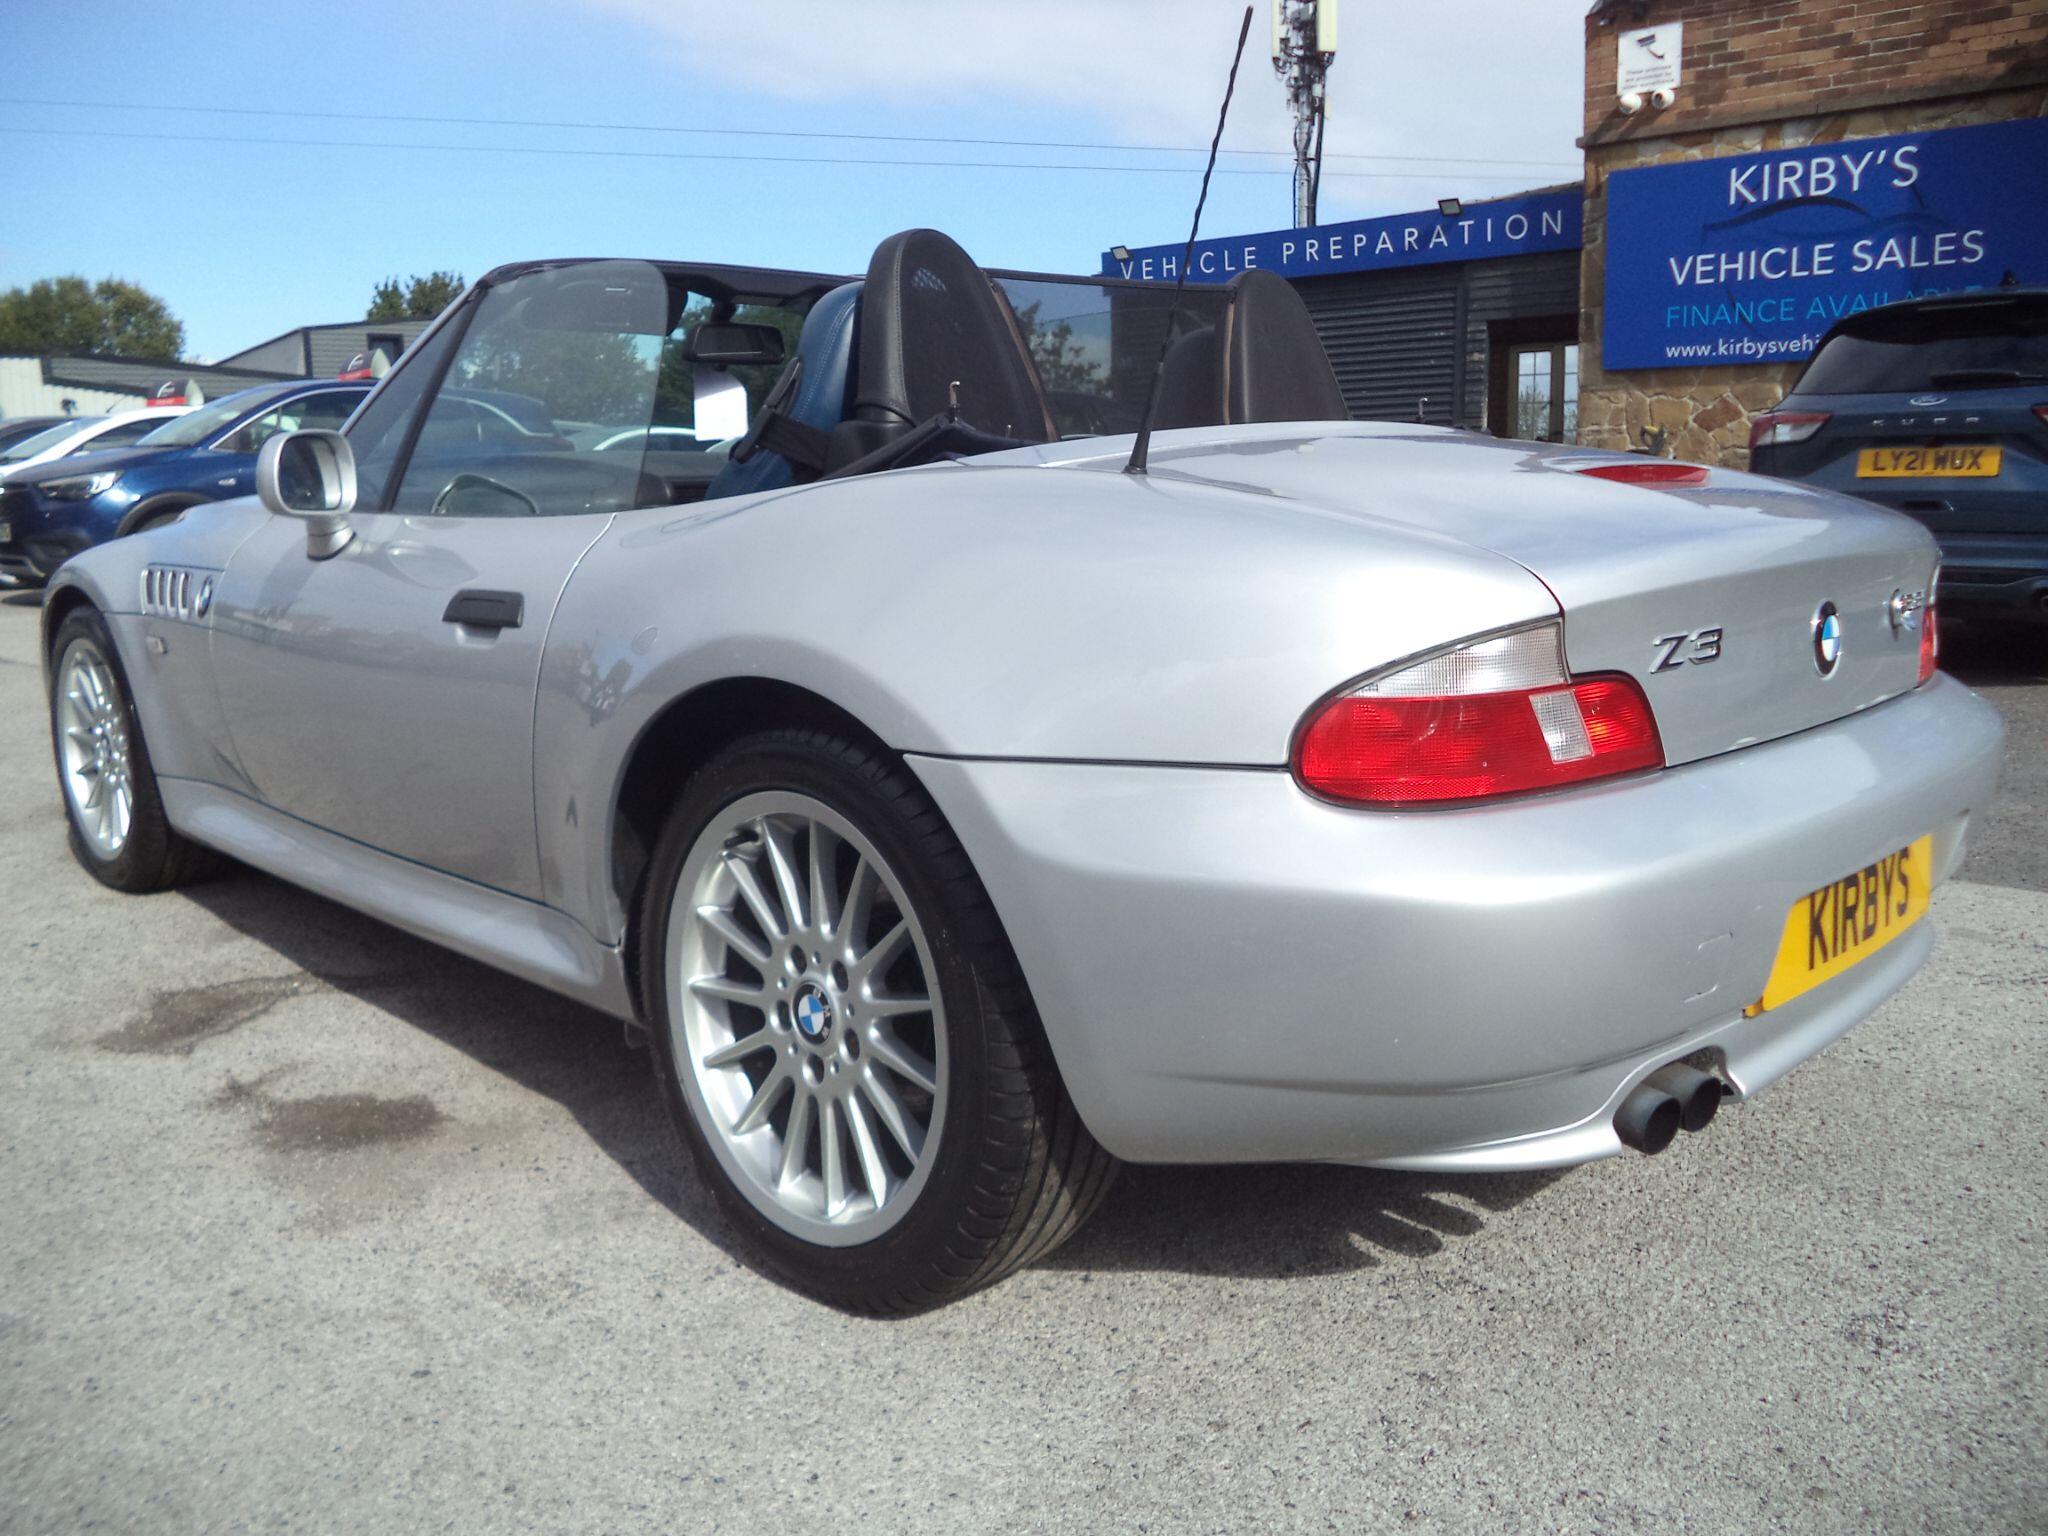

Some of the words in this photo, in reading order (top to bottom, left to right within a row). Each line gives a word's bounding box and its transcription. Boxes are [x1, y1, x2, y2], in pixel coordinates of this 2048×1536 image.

[1728, 145, 1920, 205] KIRBY'S
[1283, 209, 1563, 264] PREPARATION
[1669, 243, 1835, 286] VEHICLE
[1851, 229, 1985, 274] SALES
[1665, 298, 1796, 329] FINANCE
[1649, 625, 1723, 674] Z3
[1809, 846, 1910, 971] KIRBYS
